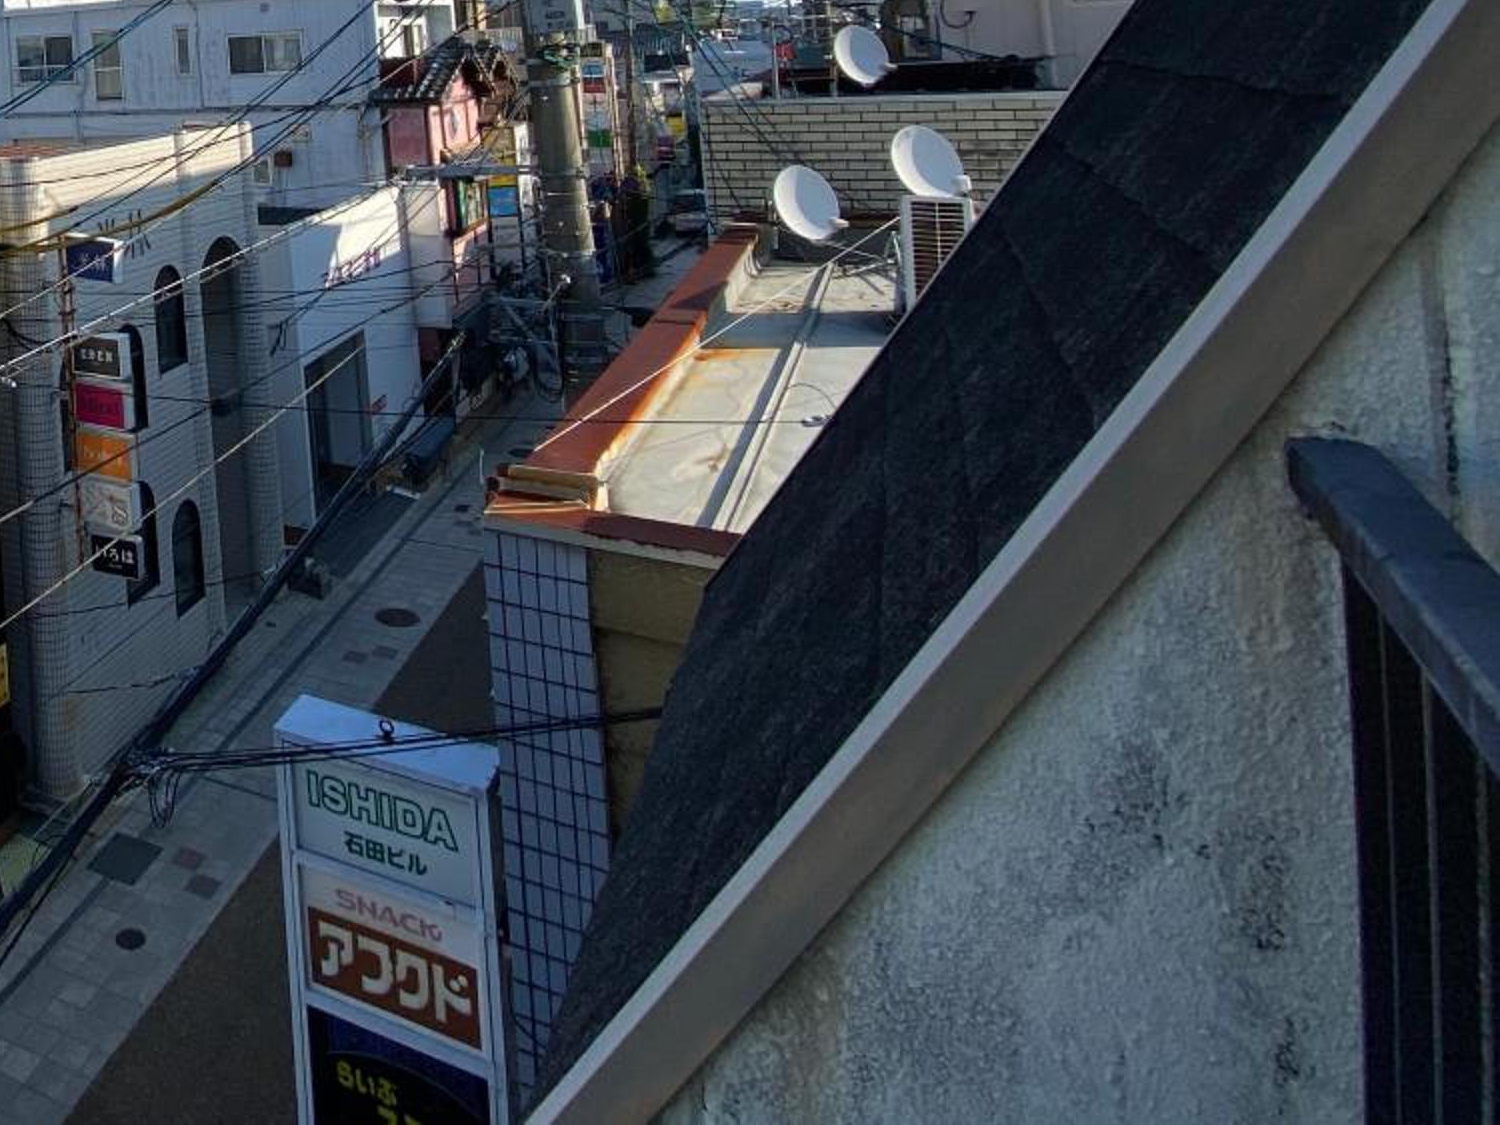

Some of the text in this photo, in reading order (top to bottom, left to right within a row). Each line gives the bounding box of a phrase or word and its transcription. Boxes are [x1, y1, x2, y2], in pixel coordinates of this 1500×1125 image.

[305, 768, 460, 853] ISHIDA
[343, 829, 429, 876] 石田ビル
[334, 887, 444, 943] SNACK
